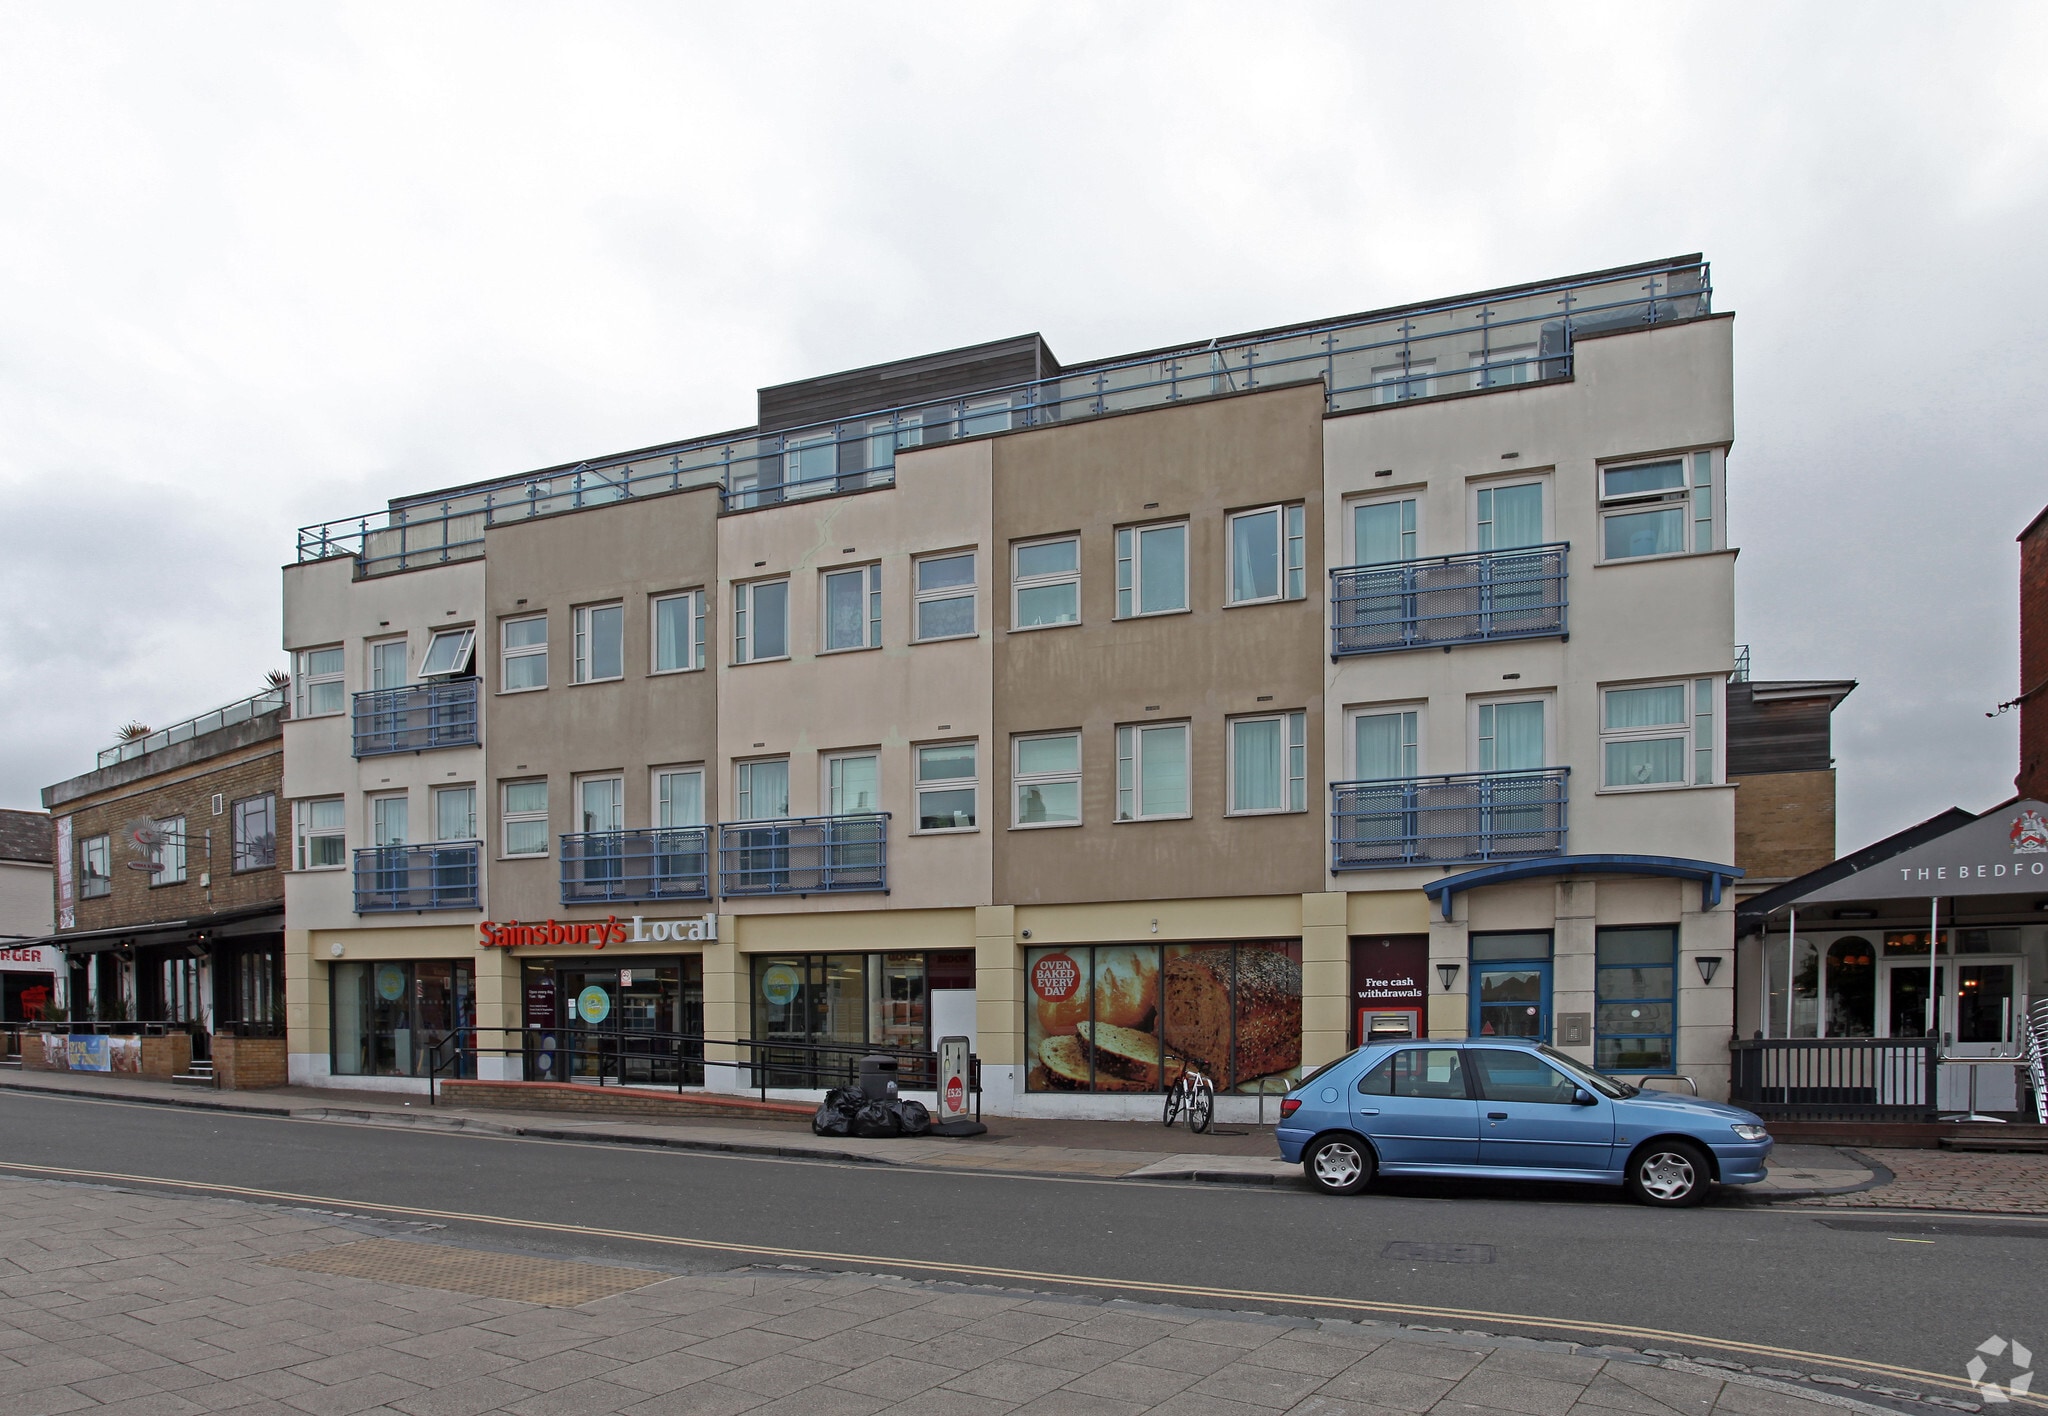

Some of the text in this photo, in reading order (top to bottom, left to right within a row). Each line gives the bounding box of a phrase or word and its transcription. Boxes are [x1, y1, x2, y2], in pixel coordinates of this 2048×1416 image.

[1900, 866, 1947, 881] THE
[479, 912, 718, 950] Sainsbury's Local
[1040, 960, 1071, 970] OVEN
[1036, 969, 1075, 979] BAKED
[1037, 978, 1074, 988] EVERY
[1365, 977, 1415, 987] Free cash
[1044, 986, 1066, 996] DAY
[1357, 988, 1423, 998] withdrawals
